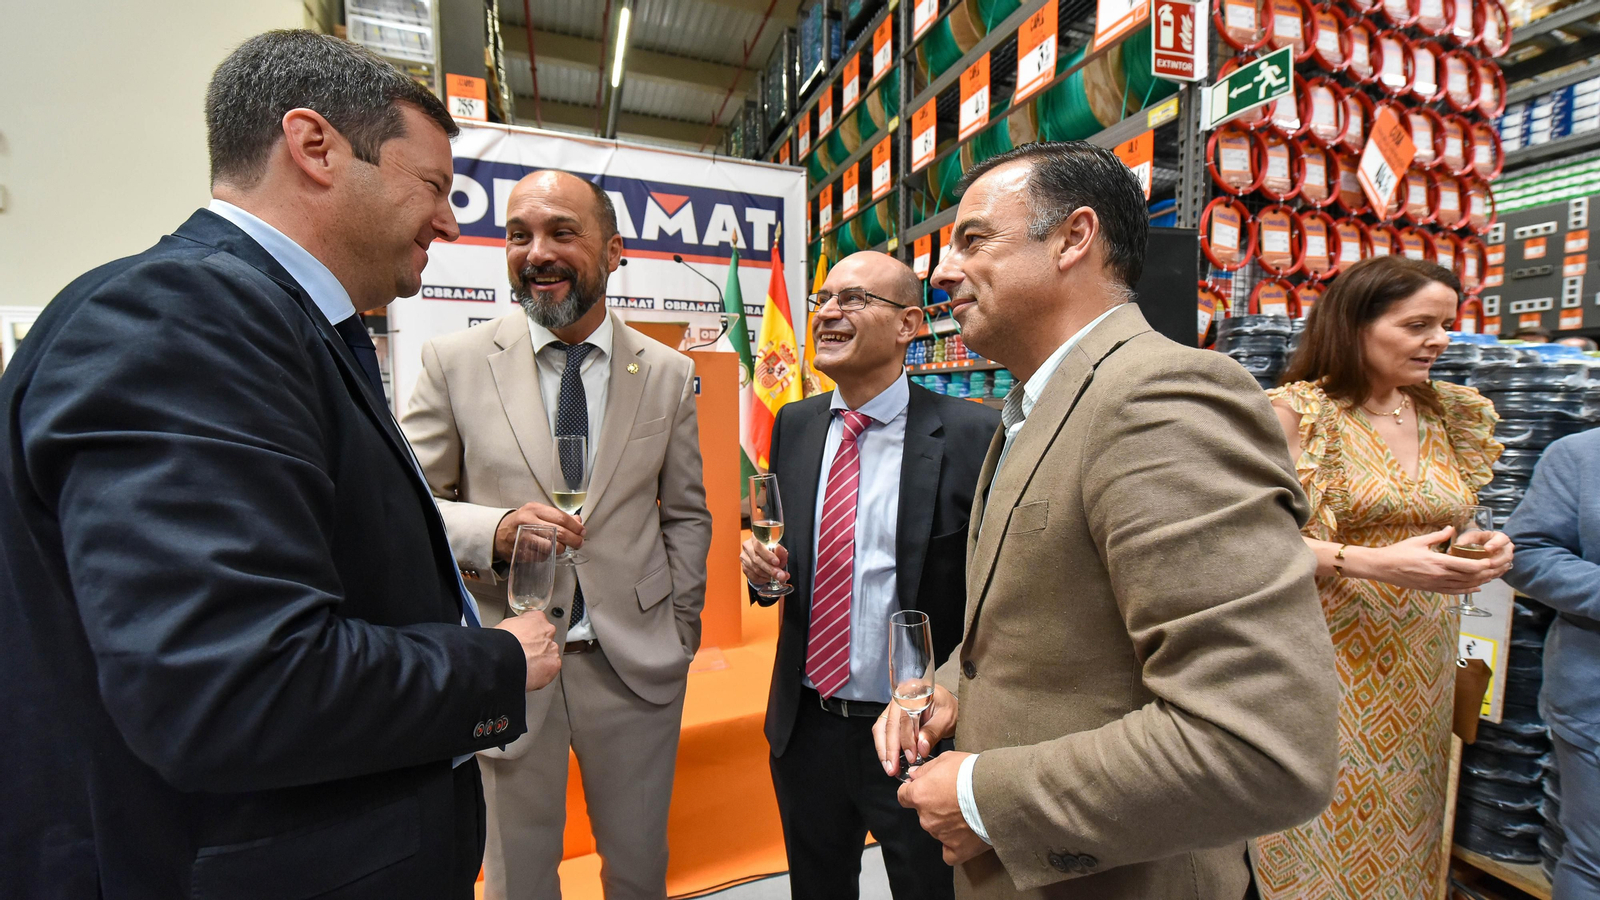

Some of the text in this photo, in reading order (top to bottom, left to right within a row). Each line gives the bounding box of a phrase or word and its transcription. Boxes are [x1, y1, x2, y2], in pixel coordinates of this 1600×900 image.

[1156, 58, 1193, 72] EXTINTOR
[423, 287, 494, 300] OBRAMAT
[606, 297, 653, 309] BRAMAT
[664, 300, 720, 313] OBRAMAT
